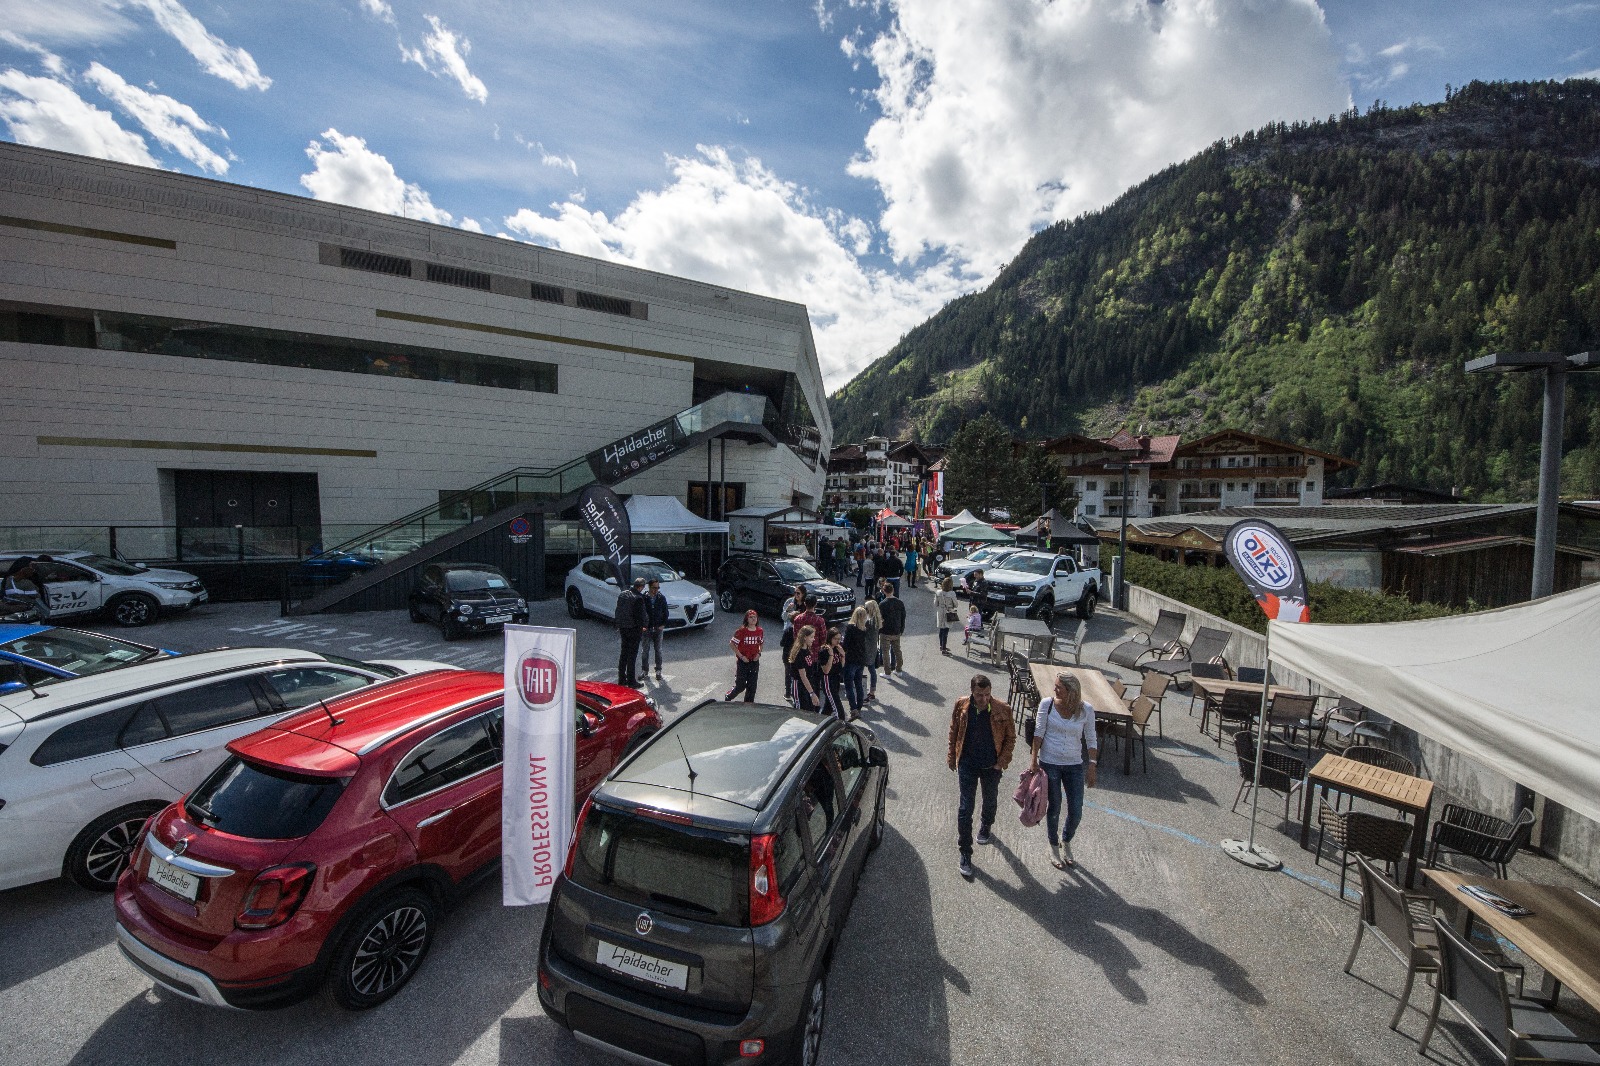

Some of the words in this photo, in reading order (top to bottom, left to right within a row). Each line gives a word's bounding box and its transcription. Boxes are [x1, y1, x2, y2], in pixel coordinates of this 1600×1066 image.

[603, 427, 667, 464] Haidacher
[49, 590, 88, 602] R-V
[50, 601, 88, 611] BRID
[157, 865, 191, 889] Haidacher
[612, 946, 674, 977] Haidacher
